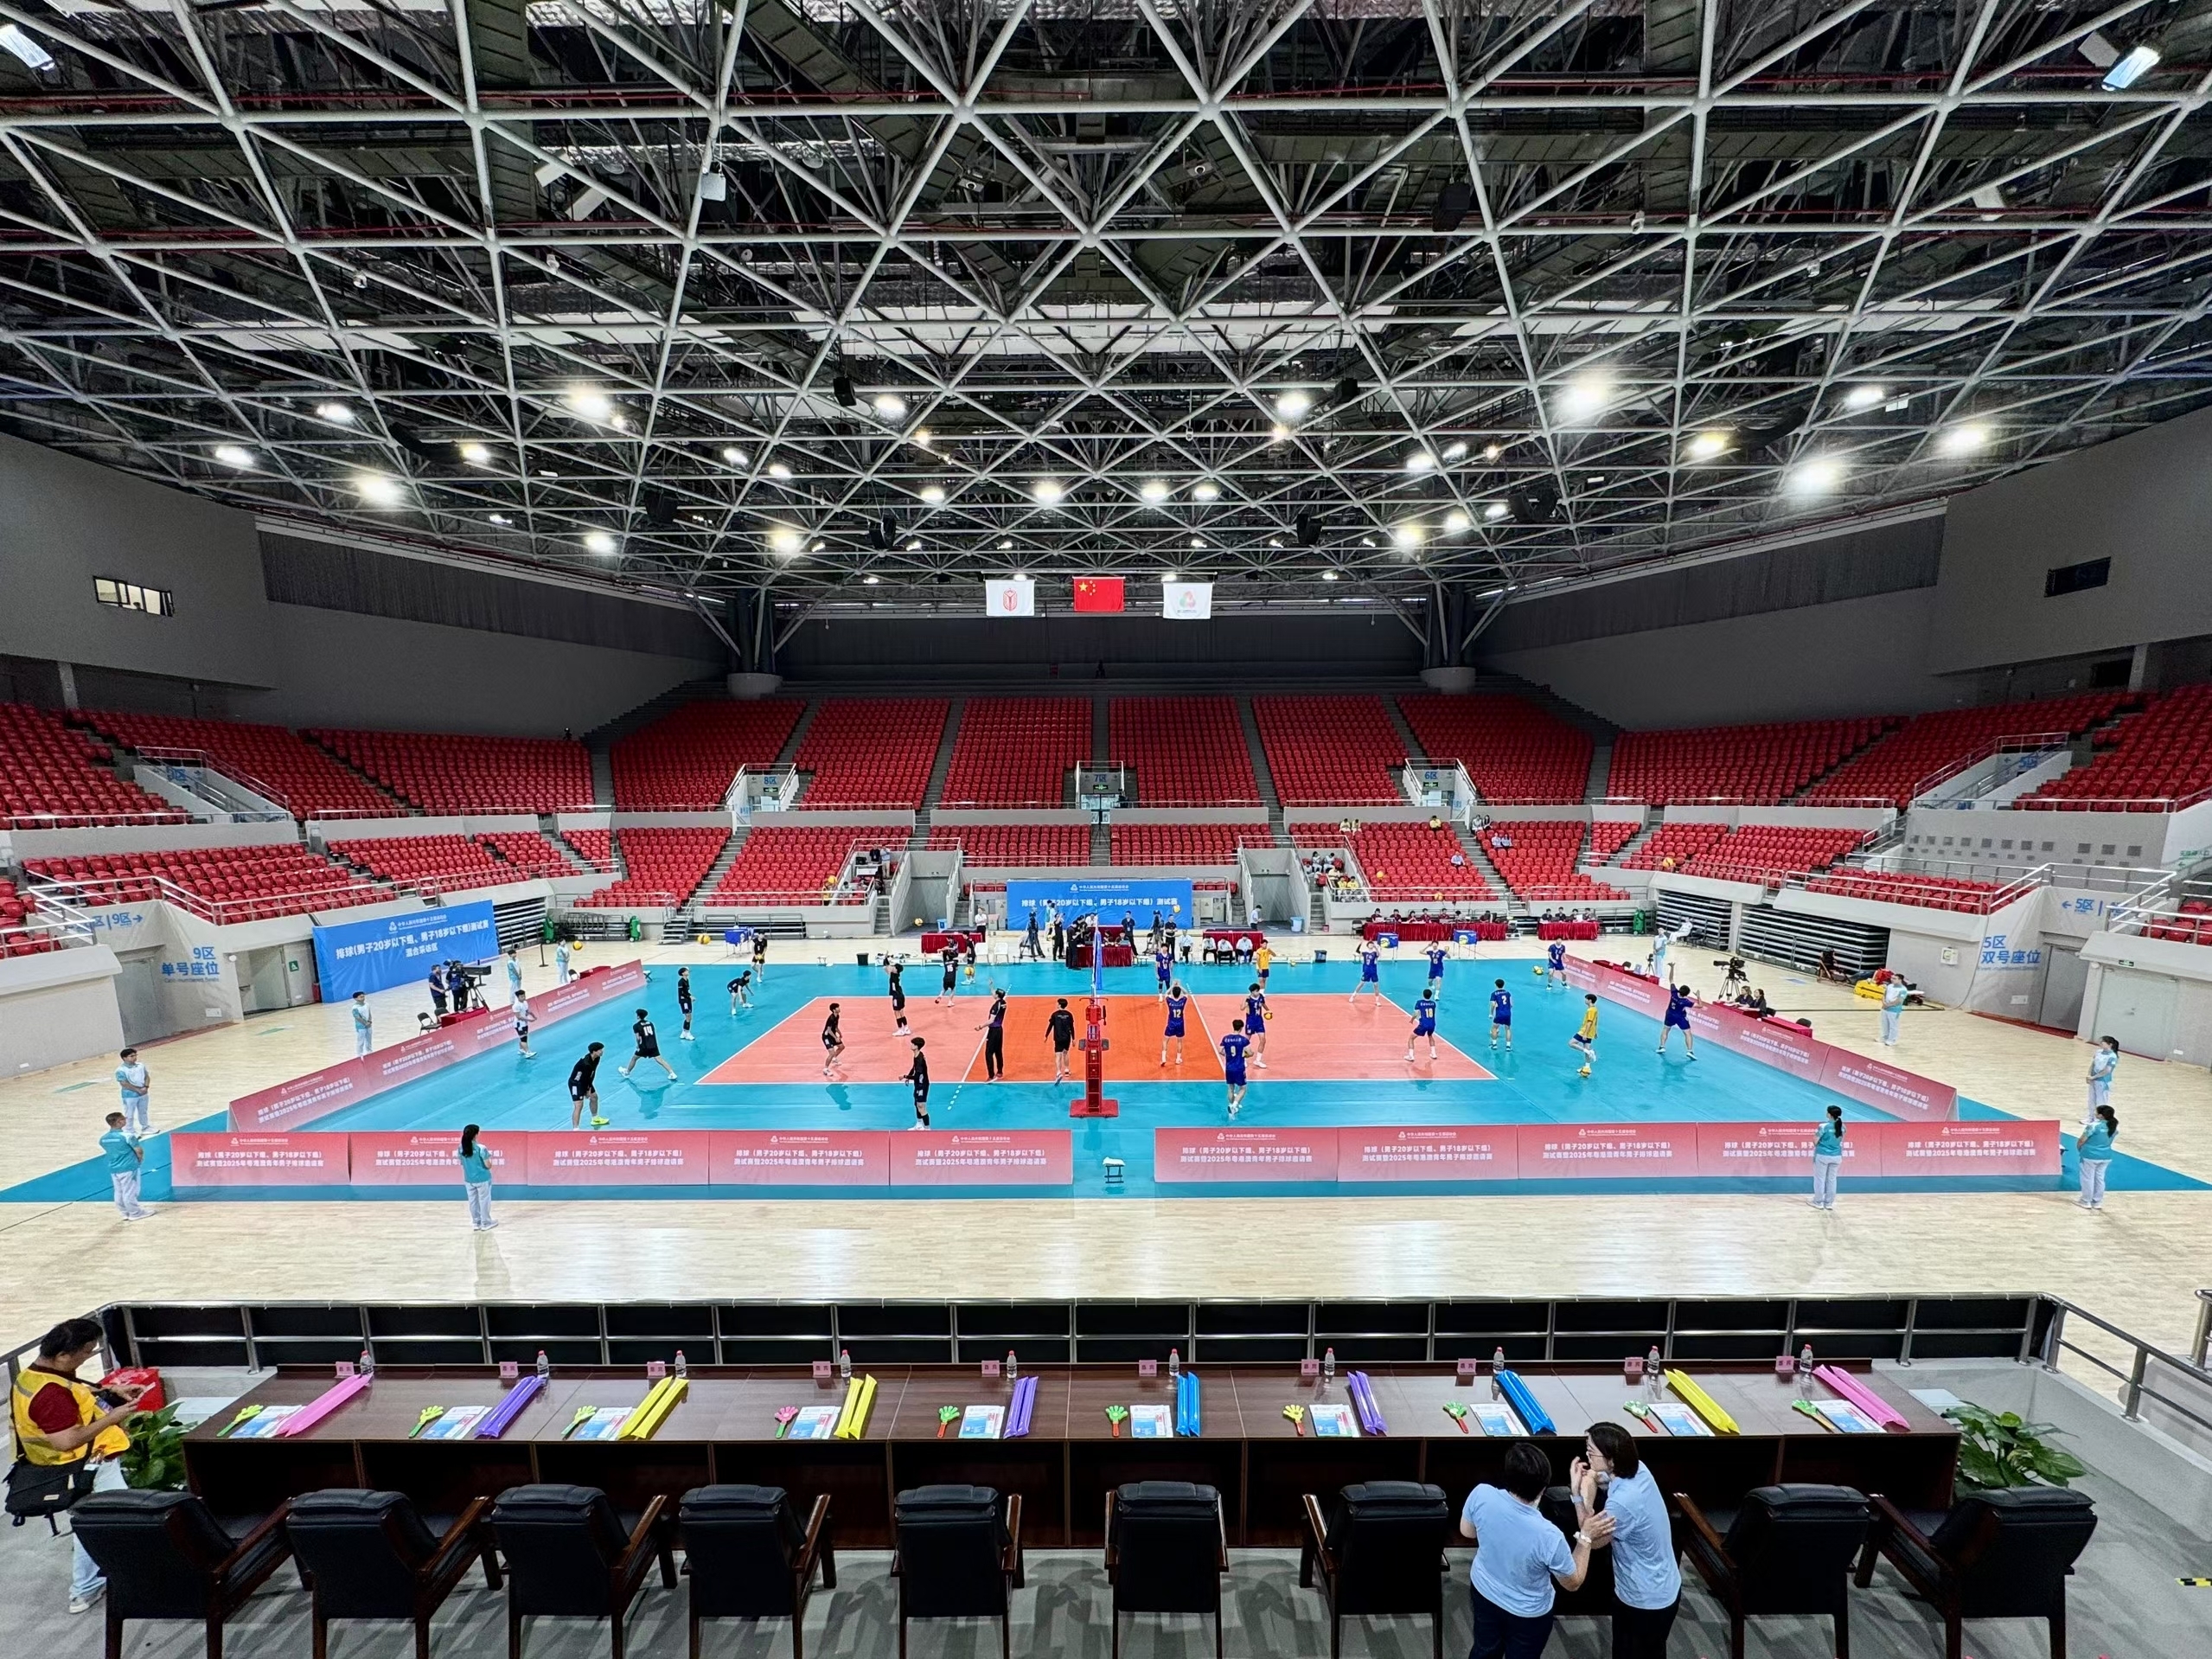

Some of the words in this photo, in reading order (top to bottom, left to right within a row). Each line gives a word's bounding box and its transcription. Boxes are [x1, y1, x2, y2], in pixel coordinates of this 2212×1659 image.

[2075, 898, 2095, 911] 5区
[112, 912, 131, 925] 9区
[1983, 935, 2007, 949] 5区
[193, 946, 216, 960] 9区
[1980, 950, 2042, 964] 双号座位
[161, 961, 220, 977] 单号座位
[1173, 1009, 1181, 1018] 12
[643, 1025, 654, 1036] 14
[1230, 1046, 1237, 1057] 9
